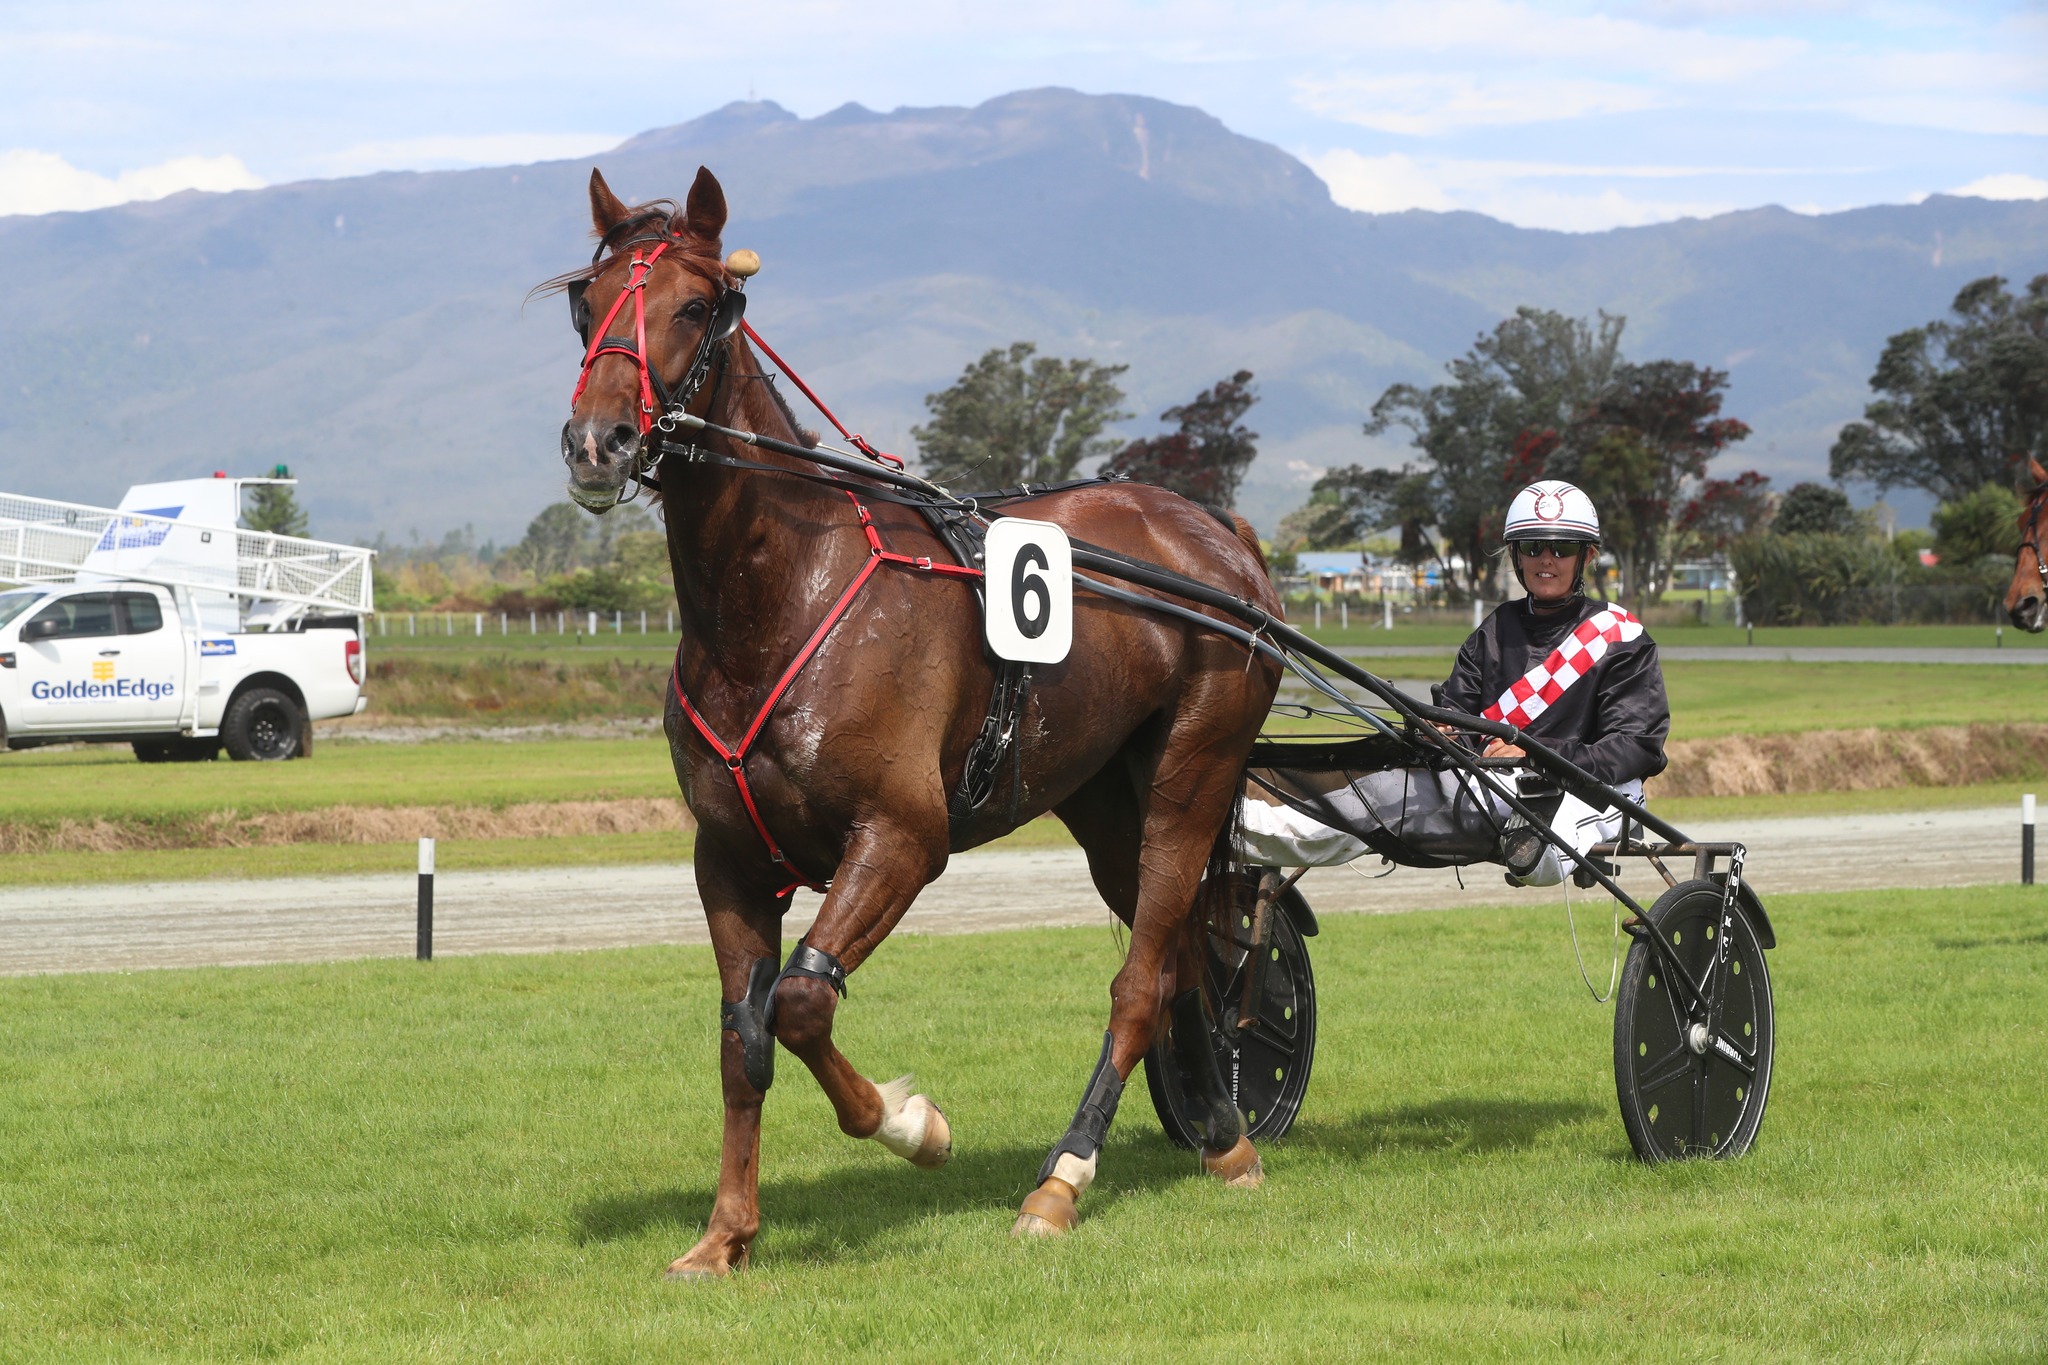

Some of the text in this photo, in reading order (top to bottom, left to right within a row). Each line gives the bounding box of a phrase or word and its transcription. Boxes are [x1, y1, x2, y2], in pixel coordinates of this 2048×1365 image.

[1011, 543, 1051, 640] 6
[32, 678, 174, 701] GoldenEdge
[1715, 1036, 1742, 1062] TURBINE
[1232, 1048, 1241, 1107] URBINE X
